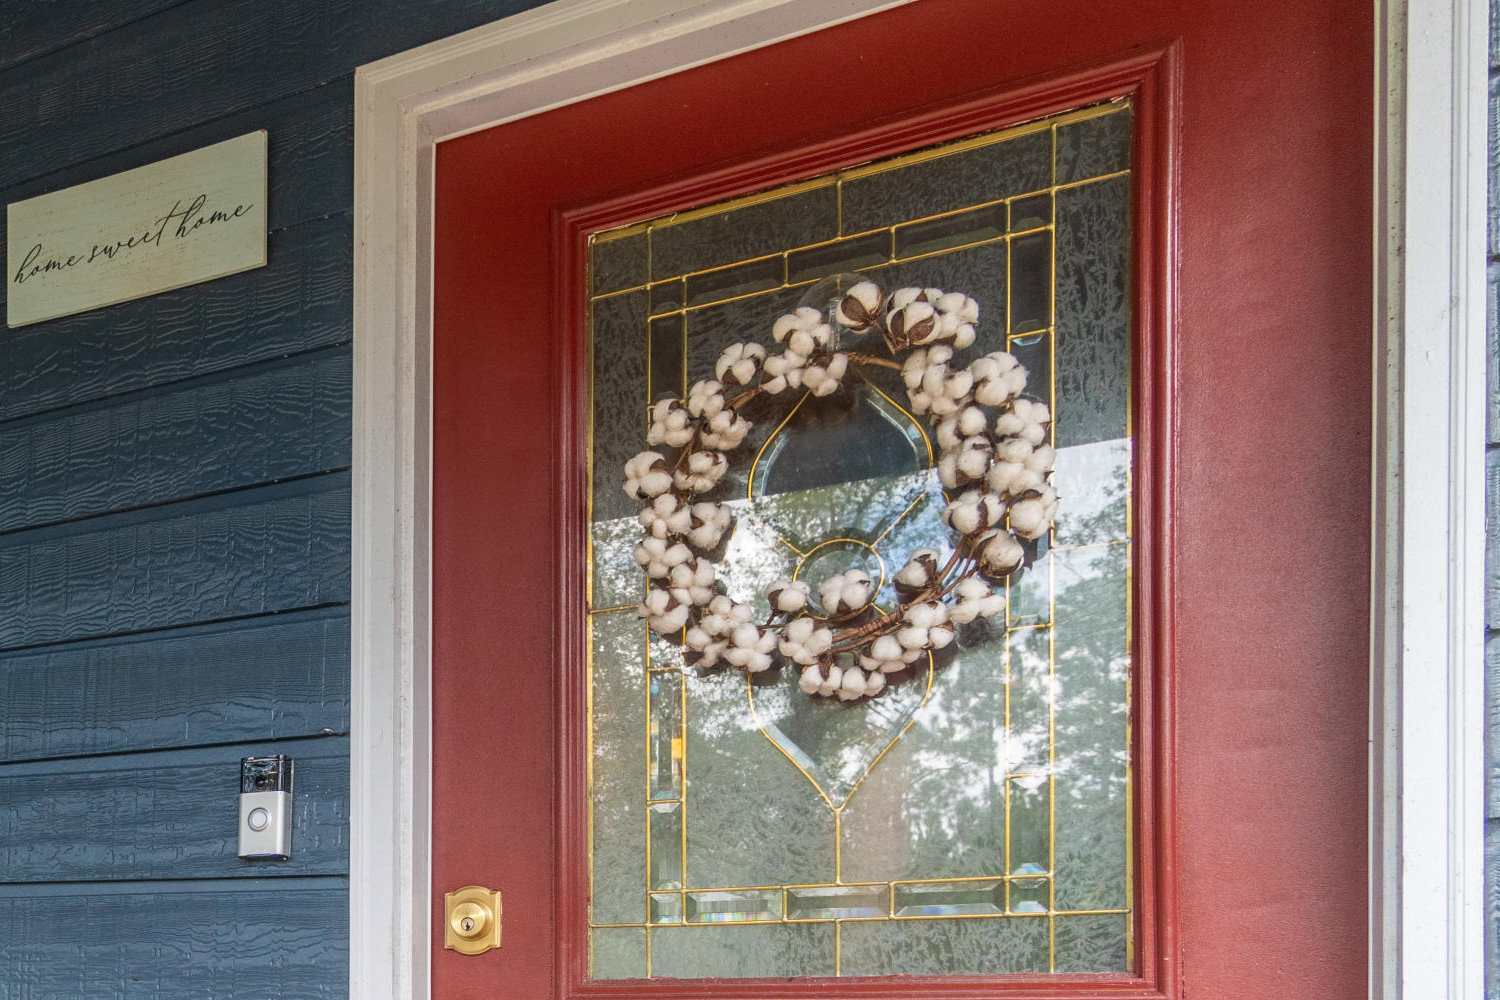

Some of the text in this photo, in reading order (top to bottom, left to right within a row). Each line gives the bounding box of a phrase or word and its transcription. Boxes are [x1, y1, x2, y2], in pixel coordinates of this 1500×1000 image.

[13, 194, 255, 284] home sweet home
